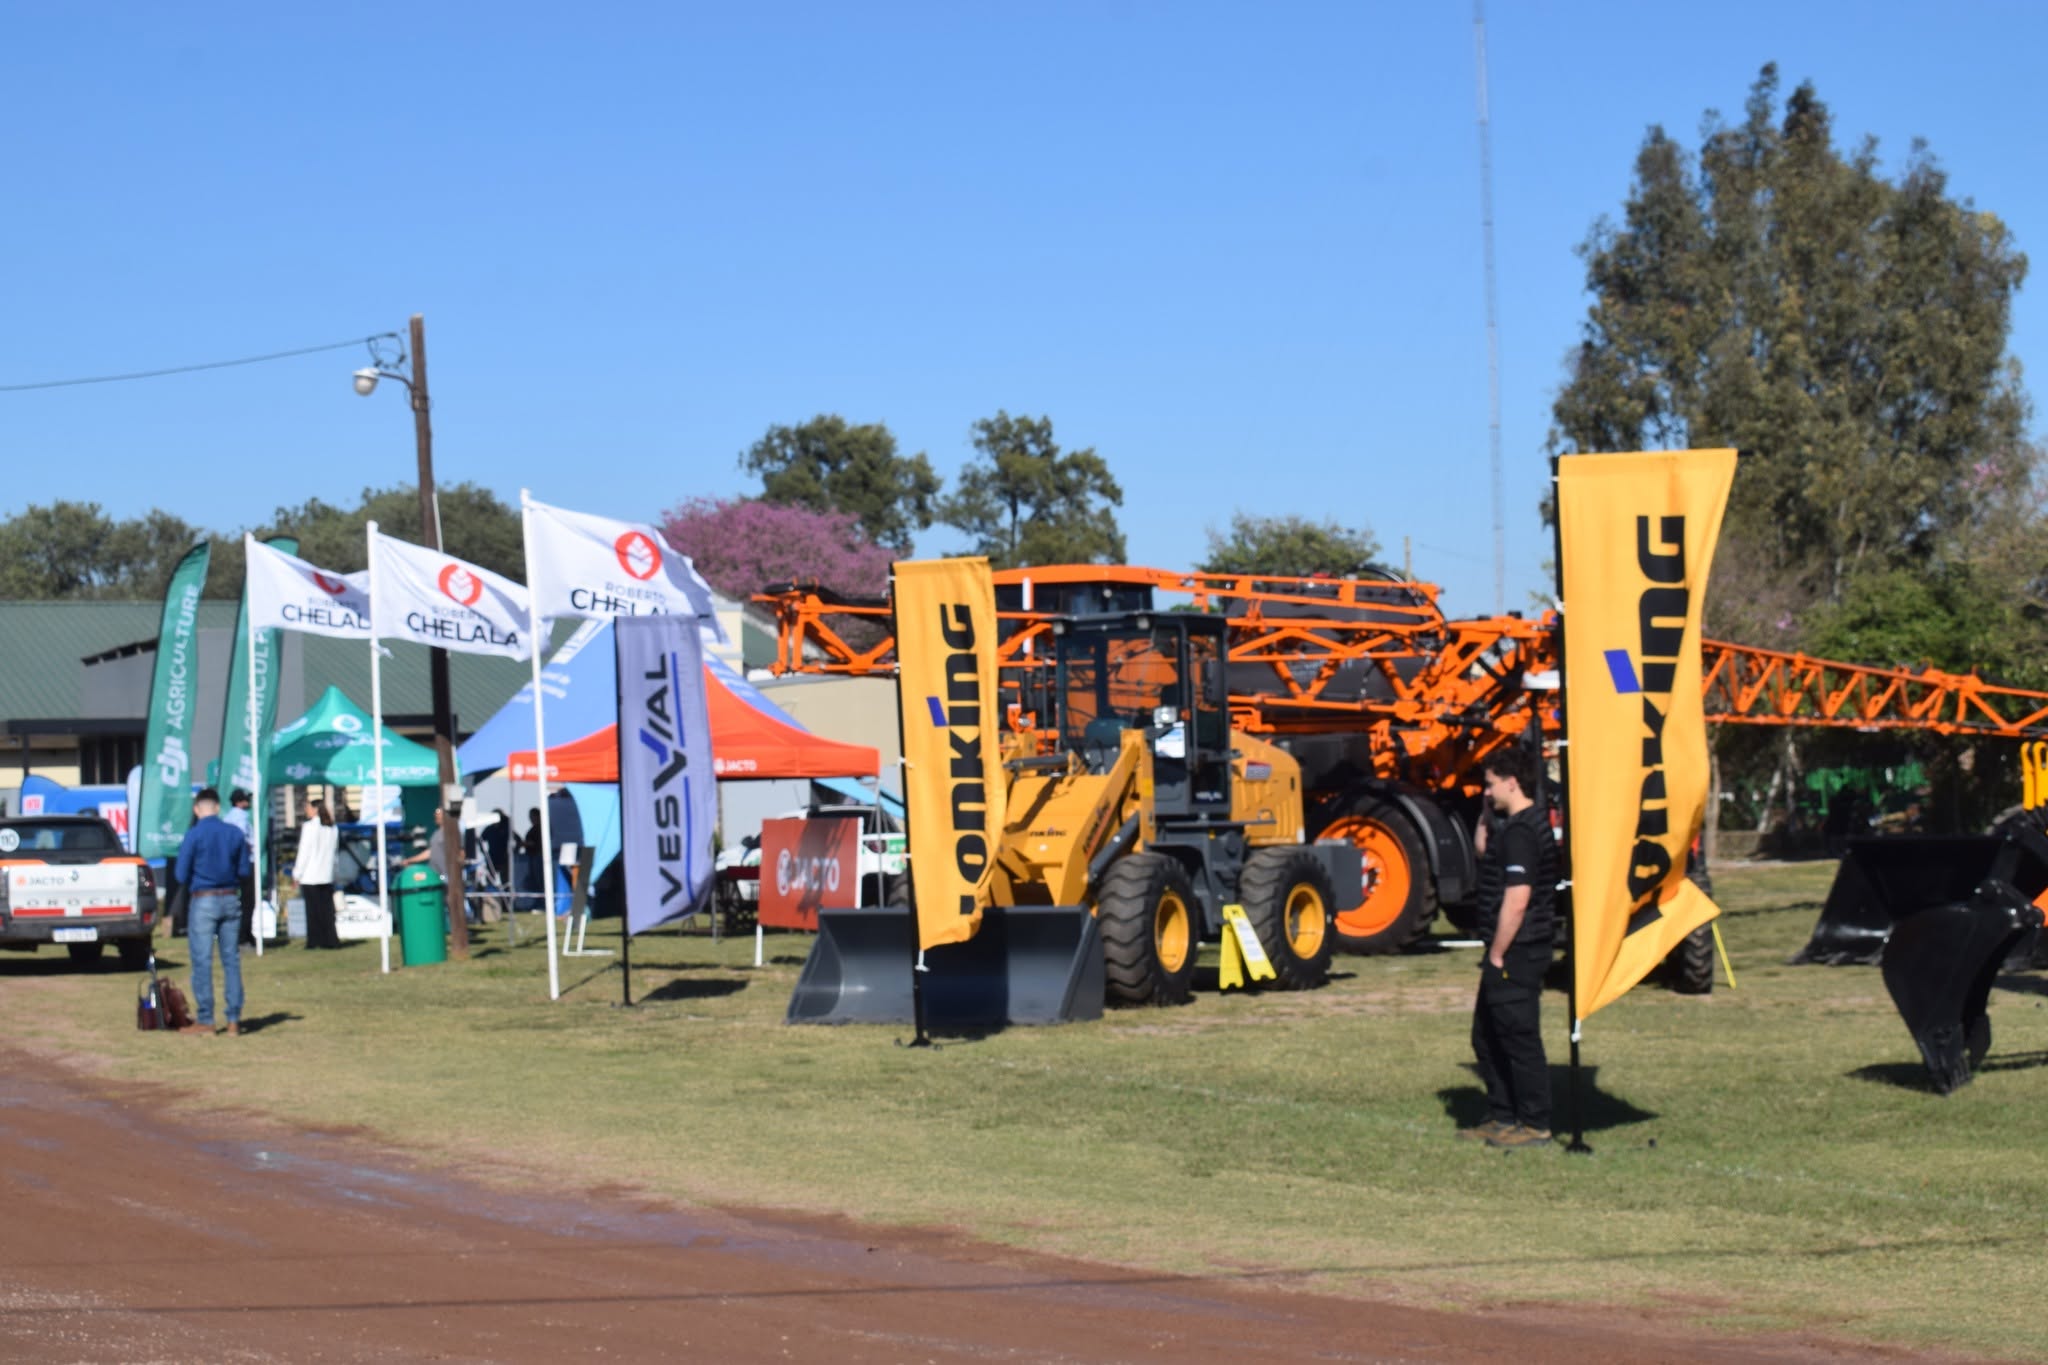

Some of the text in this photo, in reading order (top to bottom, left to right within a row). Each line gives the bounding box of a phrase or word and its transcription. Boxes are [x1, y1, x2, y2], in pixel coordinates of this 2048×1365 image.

[282, 604, 372, 630] CHELAL
[407, 612, 521, 648] CHELALA
[165, 584, 200, 730] AGRICULTURE
[526, 766, 559, 778] JATO
[724, 760, 757, 772] JACTO
[29, 877, 64, 886] JACTO
[791, 856, 840, 892] JACTO
